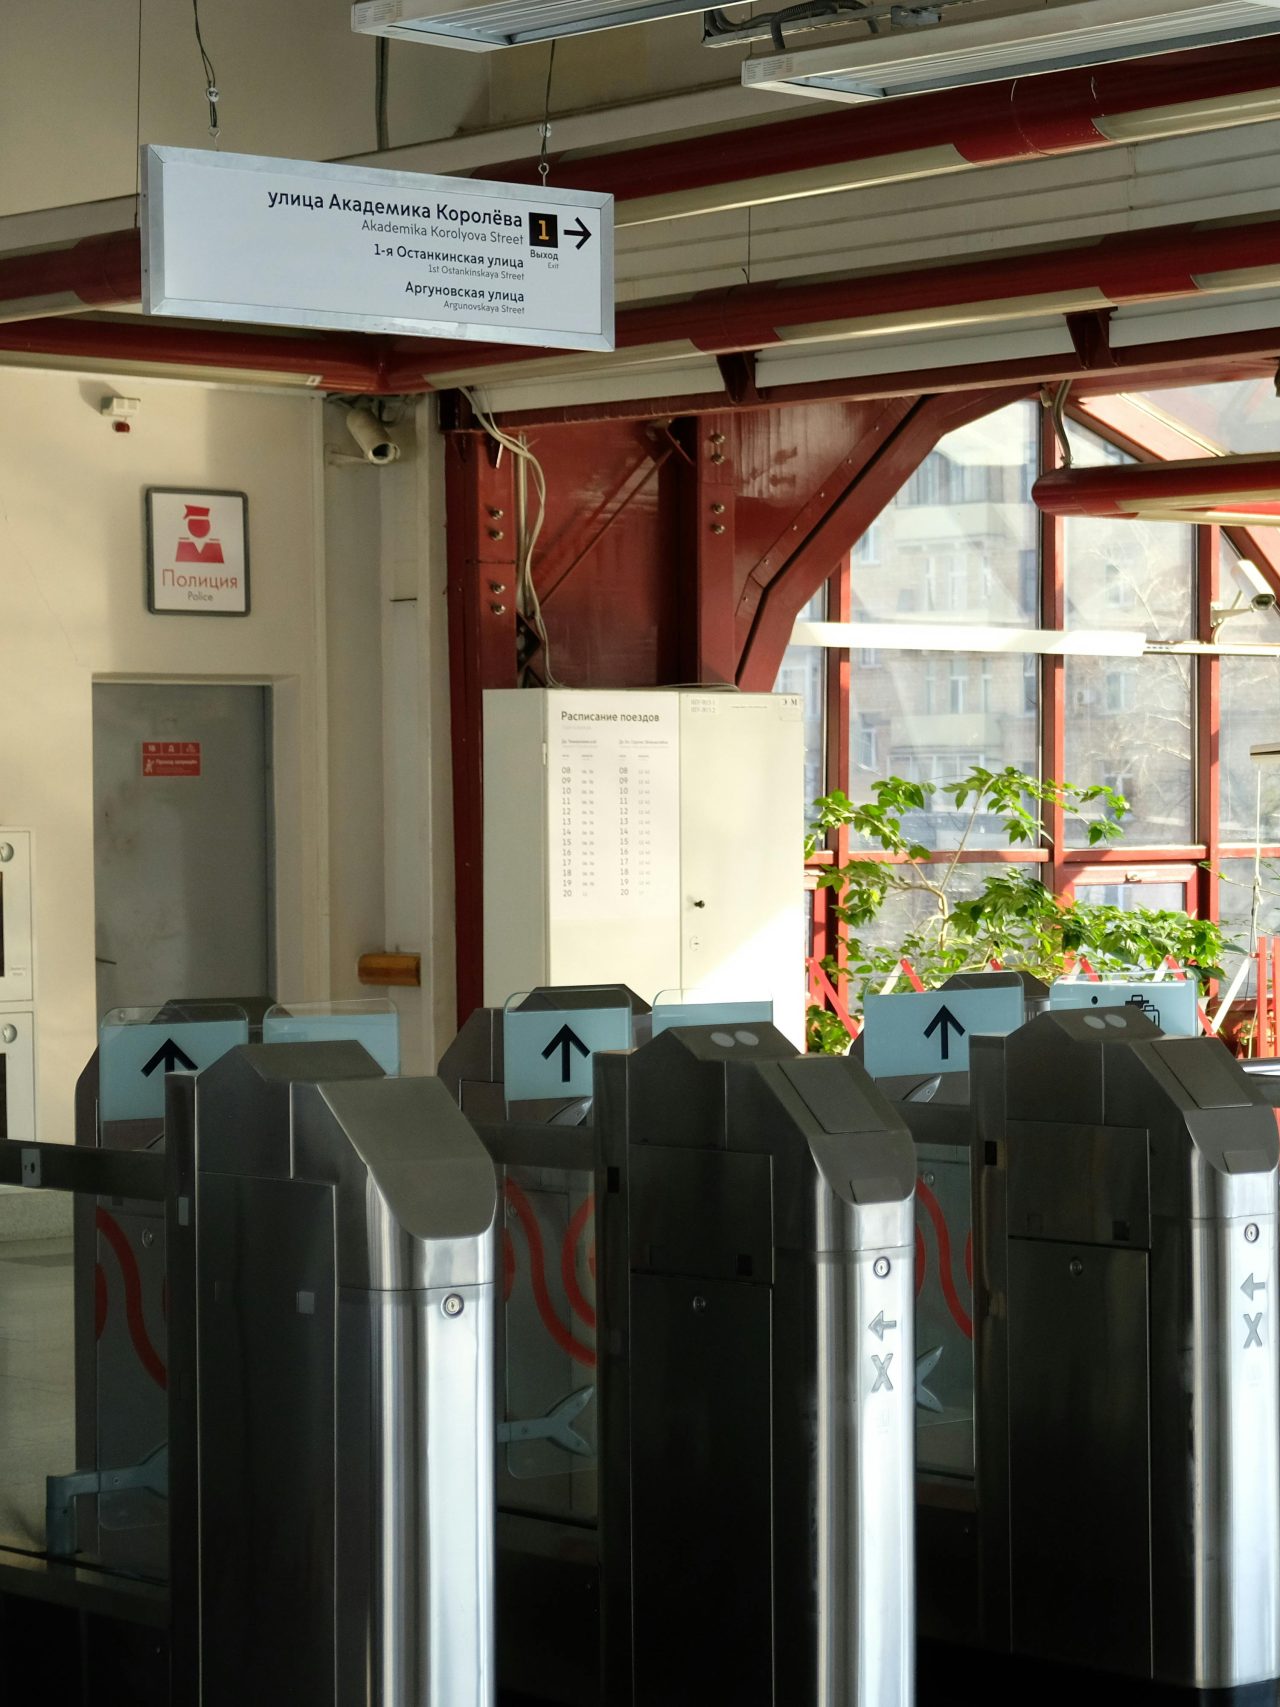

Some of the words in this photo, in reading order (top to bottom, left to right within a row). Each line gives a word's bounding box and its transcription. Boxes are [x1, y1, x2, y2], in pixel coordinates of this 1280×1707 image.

[267, 191, 324, 211] улица
[328, 193, 431, 219] Академика
[436, 203, 523, 228] Королёва
[361, 219, 427, 237] Akademika
[430, 225, 487, 243] Korolyova
[490, 230, 524, 245] Street
[538, 219, 550, 241] 1
[373, 243, 393, 257] 1-я
[396, 245, 485, 264] Останкинская
[487, 256, 524, 269] улица
[530, 249, 559, 261] Выход
[428, 264, 439, 273] 1st
[441, 265, 499, 280] Ostankinskaya
[500, 270, 525, 281] Street
[547, 262, 559, 270] Exit
[405, 281, 485, 299] Аргуновская
[487, 290, 525, 303] улица
[443, 300, 499, 313] Argunovskaya
[501, 305, 525, 315] Street
[162, 568, 238, 591] Полиция
[187, 591, 214, 602] Police
[561, 711, 618, 722] Расписание
[620, 713, 660, 723] поездов
